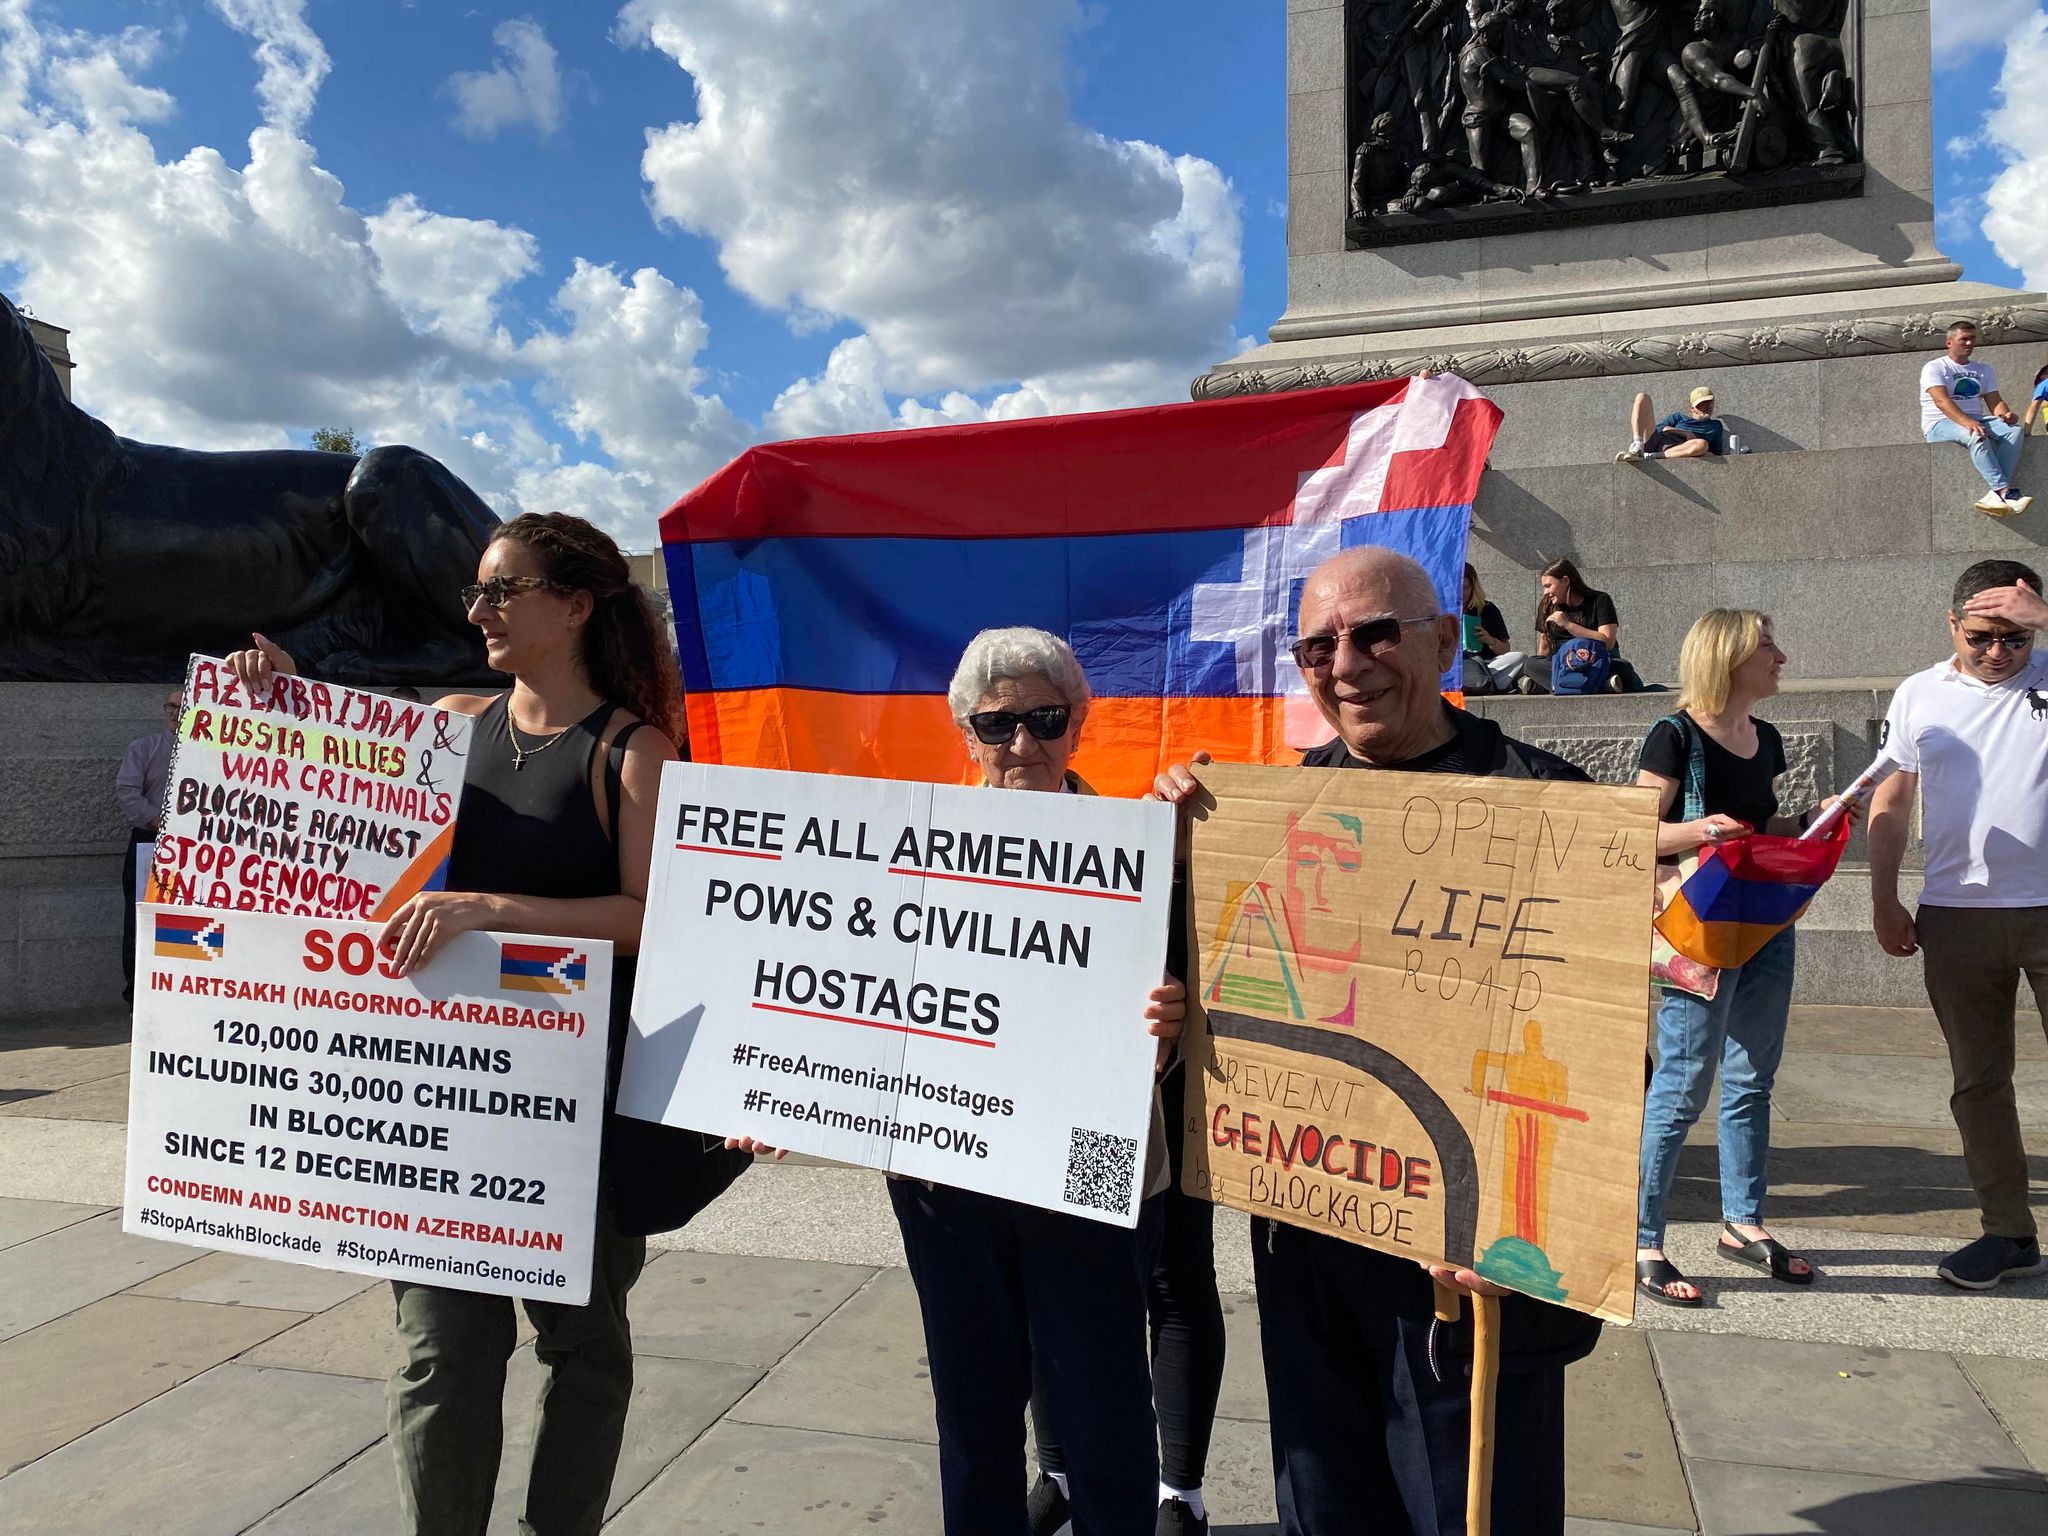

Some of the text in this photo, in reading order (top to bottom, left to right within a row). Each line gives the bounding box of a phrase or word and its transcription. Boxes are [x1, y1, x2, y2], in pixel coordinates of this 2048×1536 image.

[1359, 225, 1445, 242] ENGLAND
[1454, 215, 1536, 235] EXPECTS
[1542, 209, 1601, 226] EVERY
[1610, 202, 1657, 218] MAN
[1663, 195, 1713, 212] WILL
[1717, 194, 1744, 208] DO
[1751, 188, 1781, 203] HIS
[190, 710, 446, 795] RUSSIA ALLIES &
[433, 711, 465, 756] &
[176, 778, 422, 859] BLOCKADE AGAINST
[222, 752, 452, 826] WAR CRIMINALS
[198, 816, 349, 875] HUMANITY
[676, 803, 1145, 893] FREE ALL ARMENIAN
[1401, 794, 1647, 873] OPEN the
[156, 835, 381, 919] STOP GENOCIDE
[157, 869, 196, 905] IN
[705, 878, 1091, 968] POWS & CIVILIAN
[1391, 879, 1568, 963] LIFE
[151, 971, 585, 1038] IN ARTSAKH (NAGORNO-KARABAGH)
[753, 959, 1000, 1036] HOSTAGES
[1401, 948, 1543, 1013] ROAD
[213, 1019, 512, 1074] 120,000 ARMENIANS
[732, 1043, 1015, 1118] #FreeArmenianHostages
[149, 1050, 577, 1123] INCLUDING 30,000 CHILDREN
[1209, 1053, 1365, 1118] PREVENT
[249, 1104, 449, 1151] IN BLOCKADE
[743, 1088, 989, 1160] #FreeArmenianPOWs
[1212, 1103, 1432, 1199] GENOCIDE
[164, 1131, 545, 1205] SINCE 12 DECEMBER 2022
[147, 1175, 563, 1251] CONDEMN AND SANCTION AZERBAIJAN
[1250, 1165, 1414, 1247] BLOCKADE
[140, 1208, 567, 1288] #StopArtsakhBlockade #StopArmenianGenocide
